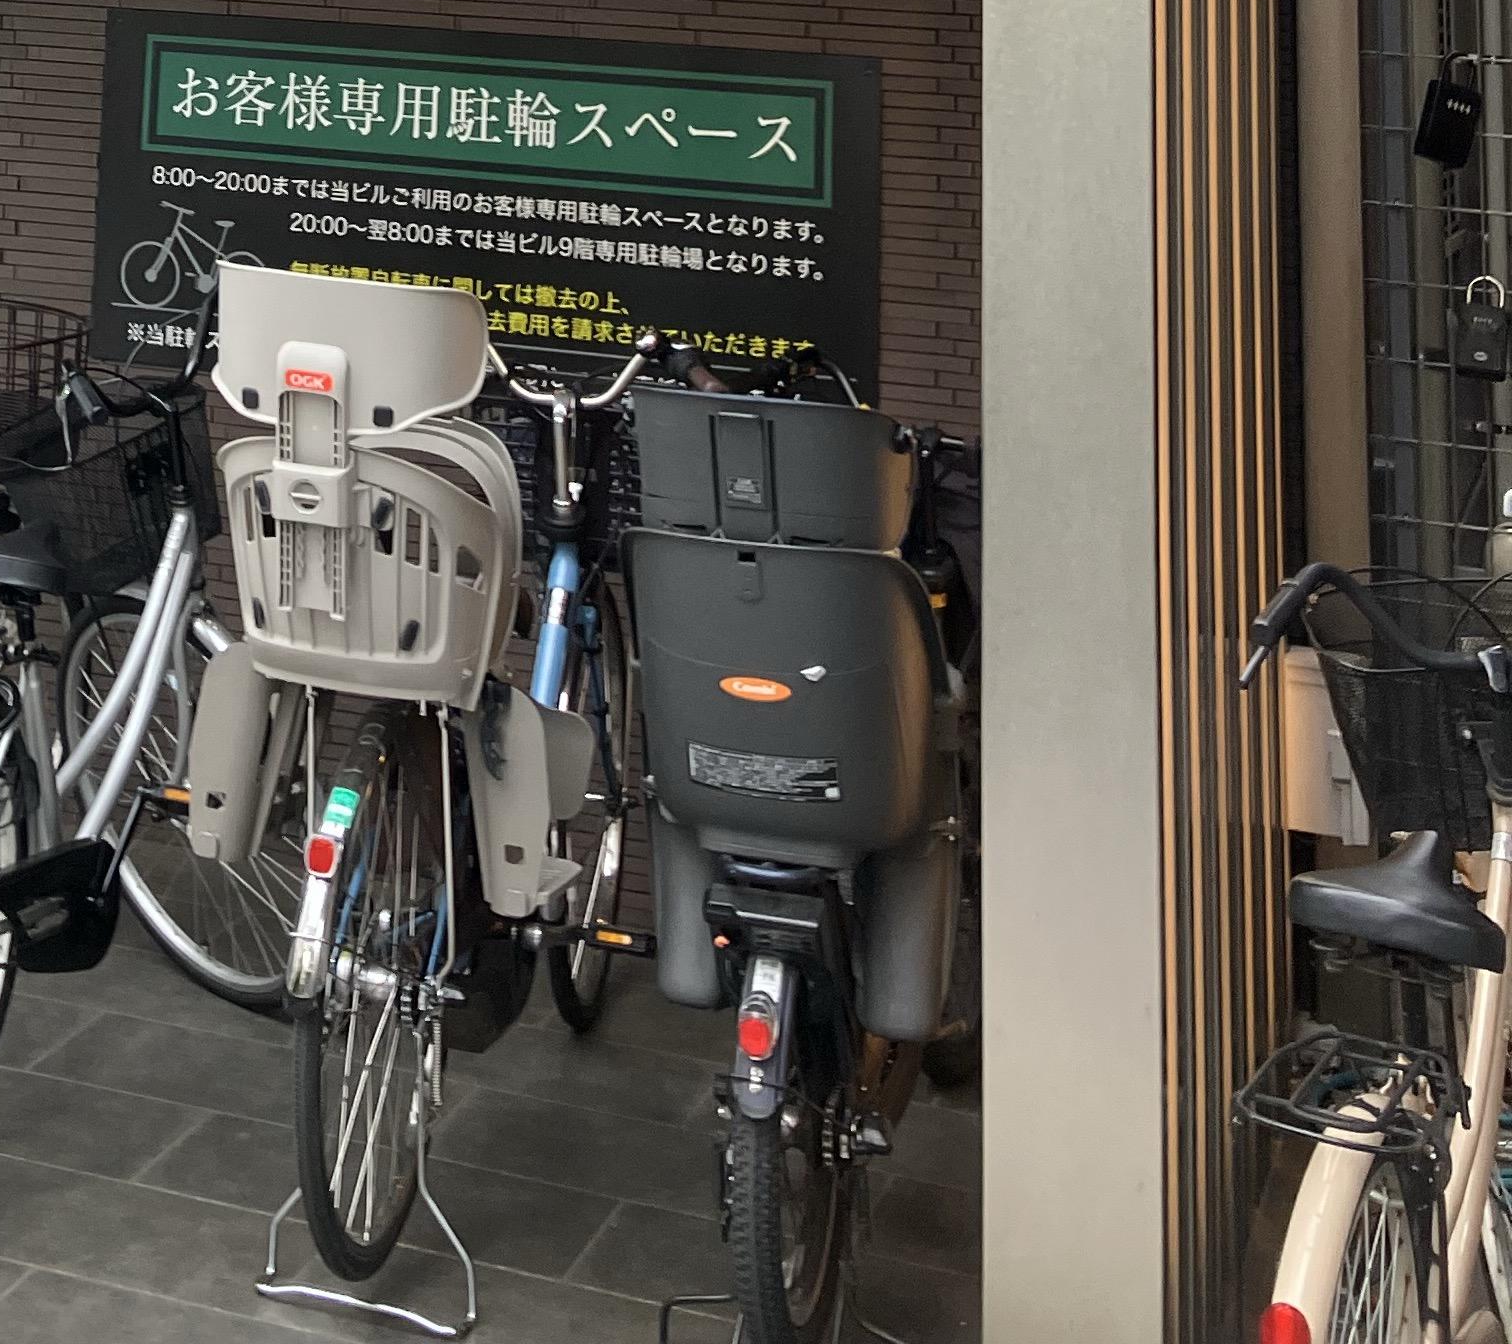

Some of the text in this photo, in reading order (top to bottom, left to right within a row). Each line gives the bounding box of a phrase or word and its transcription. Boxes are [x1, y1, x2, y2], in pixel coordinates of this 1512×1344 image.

[171, 67, 799, 163] お客様専用駐輪スペース
[289, 373, 326, 391] OGK
